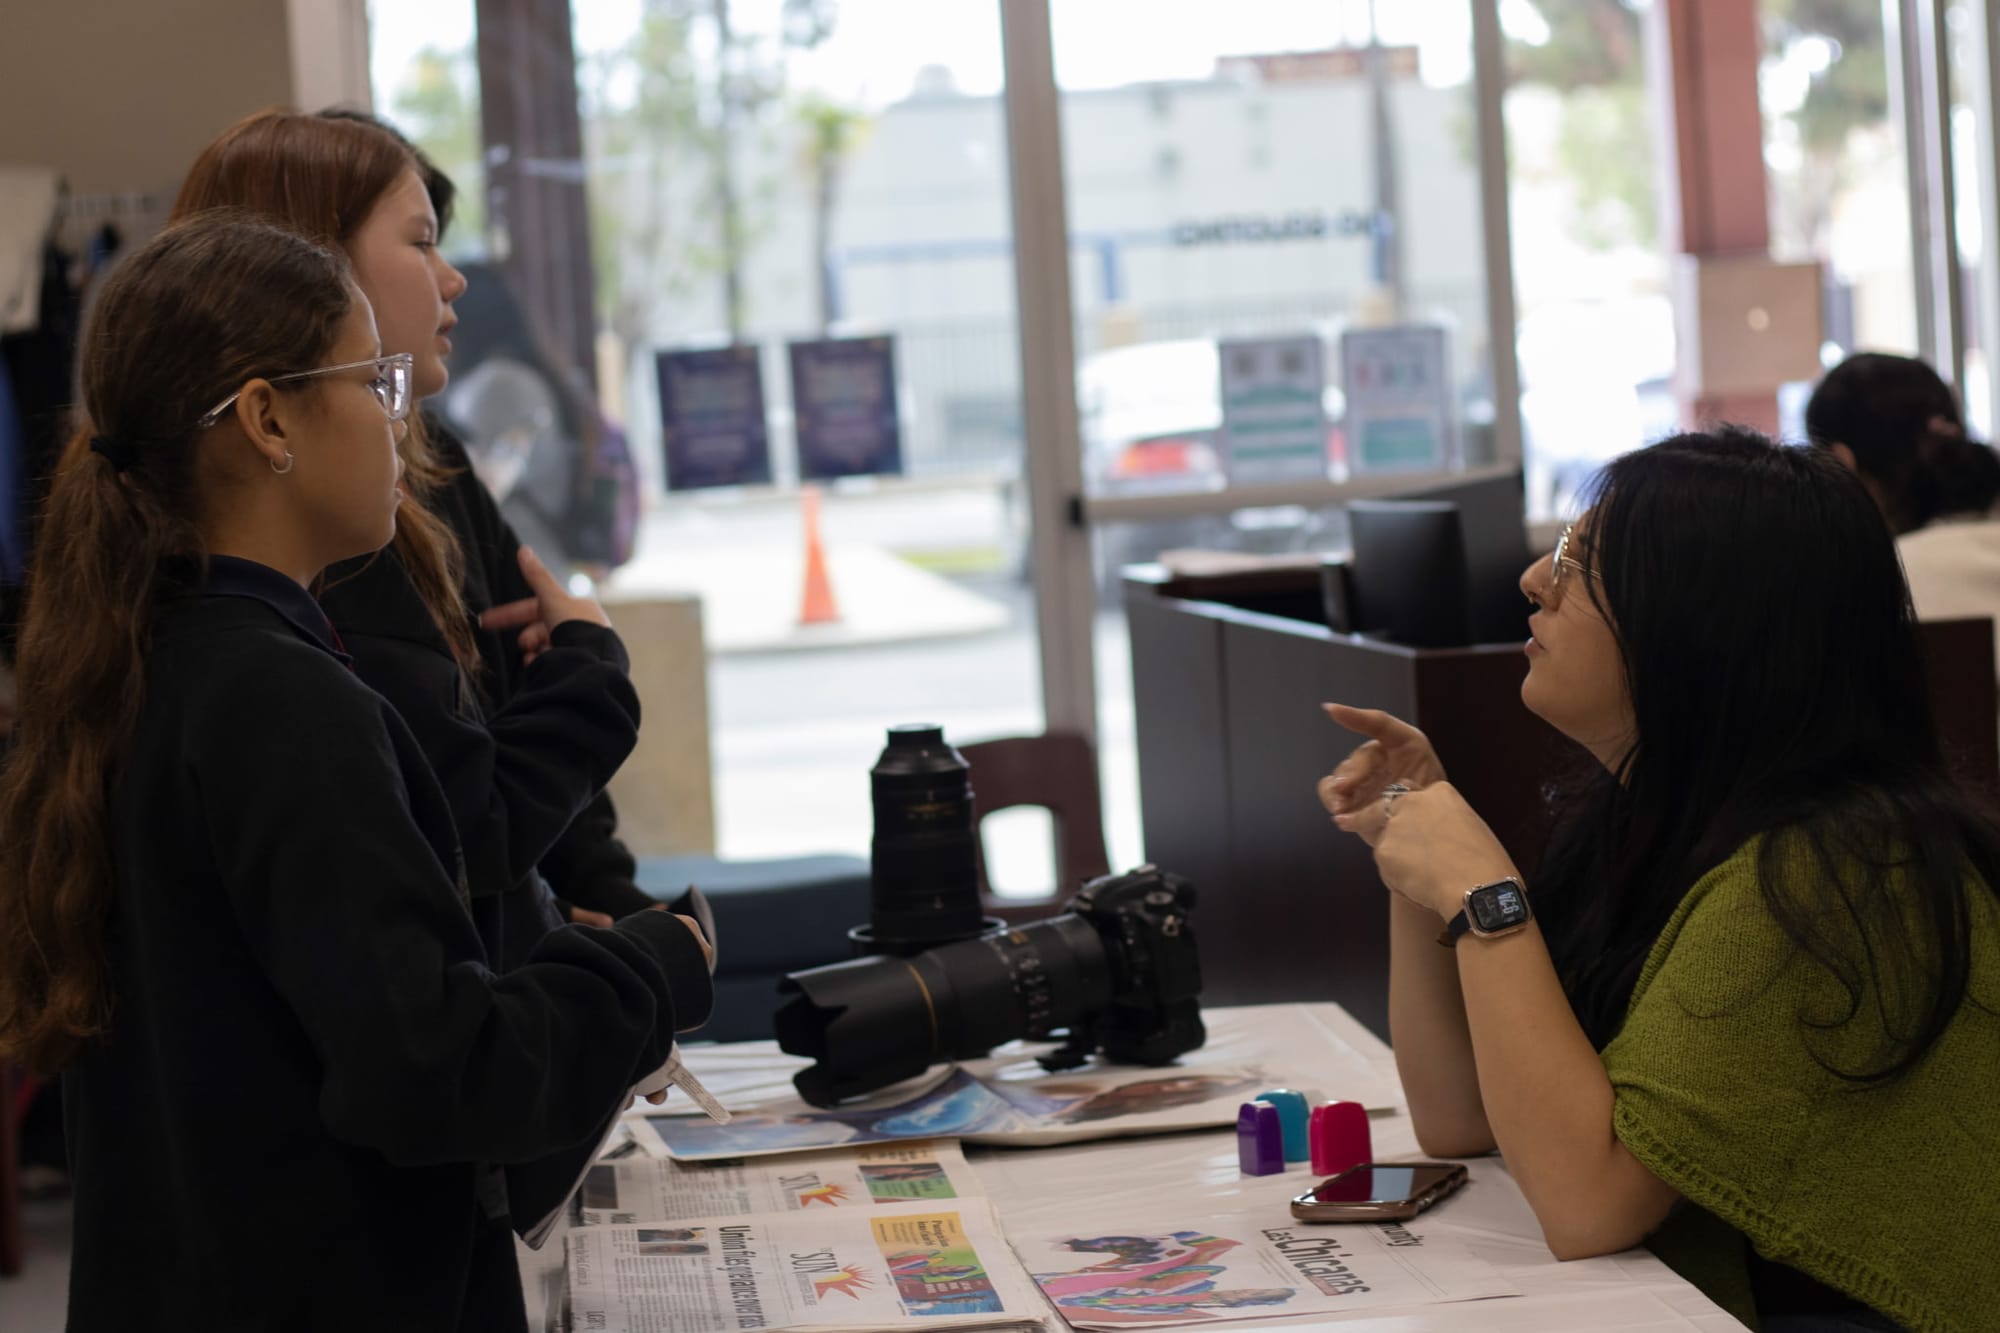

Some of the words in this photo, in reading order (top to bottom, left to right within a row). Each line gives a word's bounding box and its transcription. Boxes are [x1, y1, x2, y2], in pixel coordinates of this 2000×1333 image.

[718, 1224, 755, 1250] Union
[1261, 1226, 1295, 1242] Las
[789, 1252, 840, 1274] SUN
[1274, 1237, 1371, 1295] Chicanas
[716, 1265, 763, 1299] grievance
